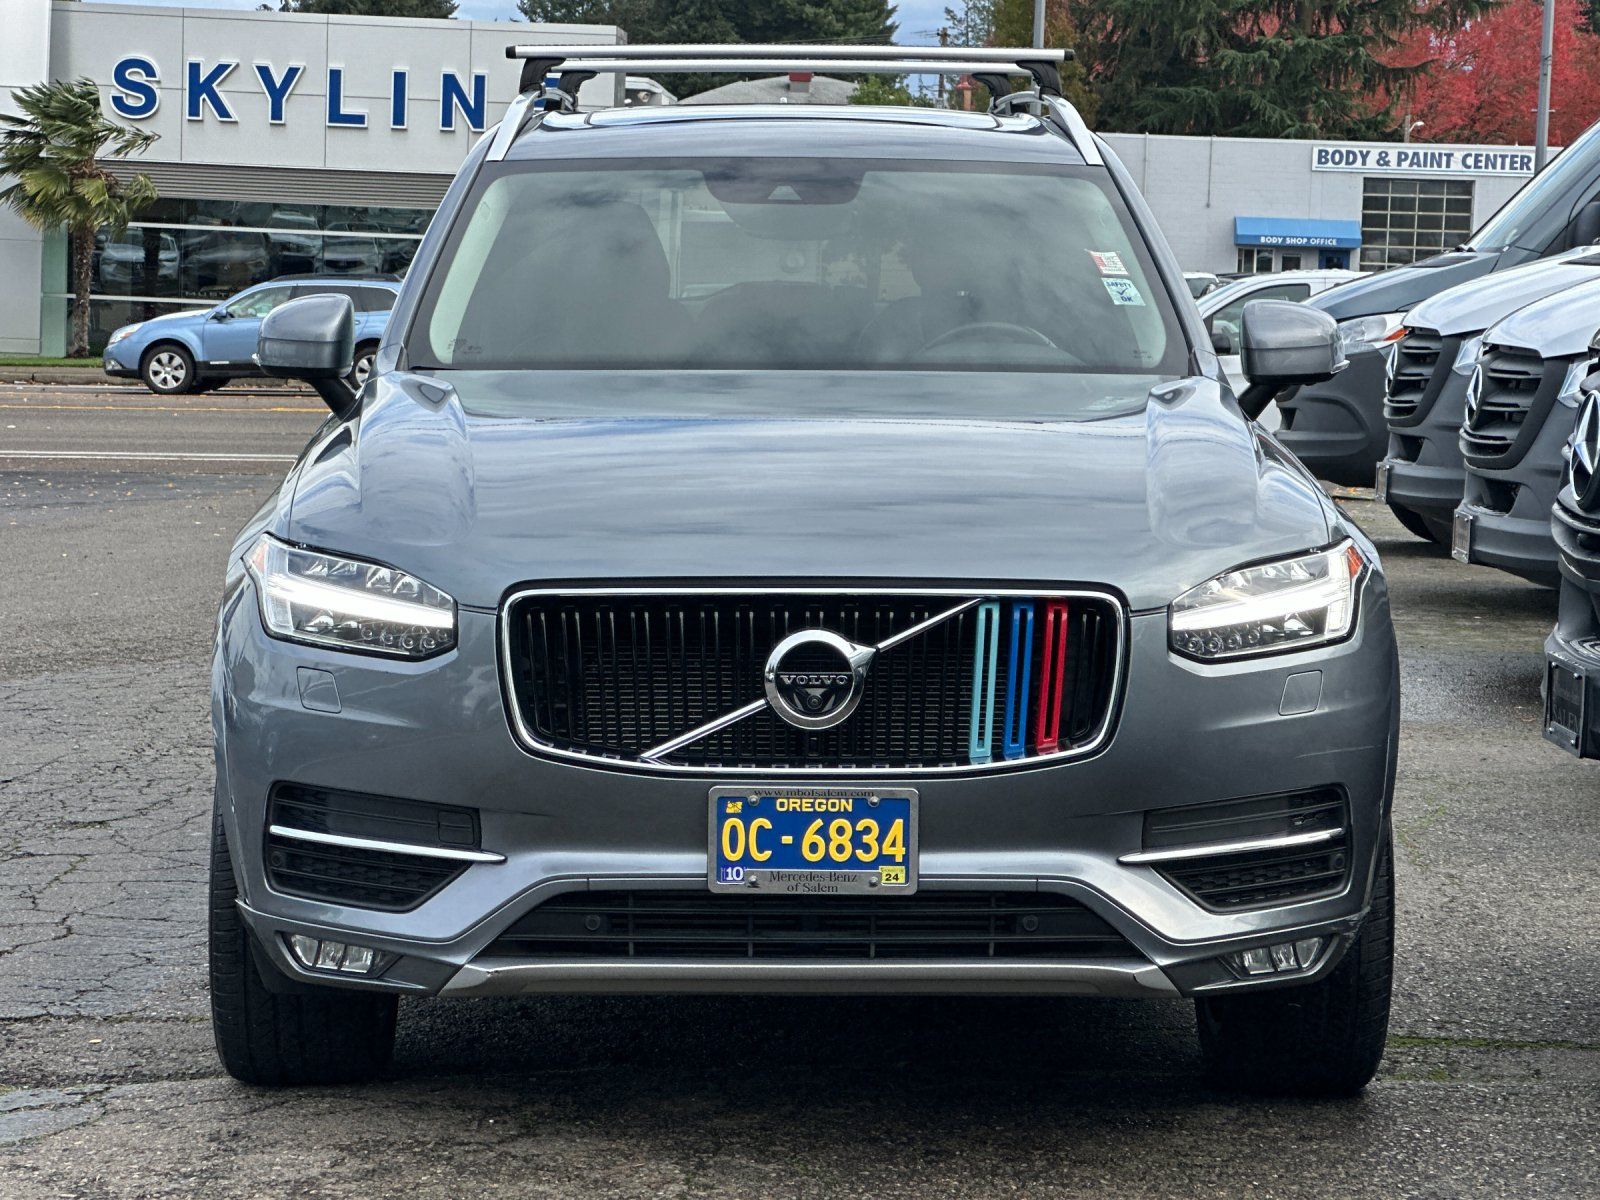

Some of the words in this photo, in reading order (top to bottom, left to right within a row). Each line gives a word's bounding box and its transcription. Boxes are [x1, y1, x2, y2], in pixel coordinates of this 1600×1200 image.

[111, 56, 561, 131] SKYLIN
[1317, 148, 1372, 167] BODY
[1376, 150, 1391, 167] &
[1397, 151, 1454, 169] PAINT
[1461, 152, 1532, 171] CENTER
[1260, 236, 1283, 244] BODY
[1286, 236, 1307, 245] SHOP
[1310, 237, 1337, 246] OFFICE
[780, 675, 848, 685] VOLVO
[754, 789, 874, 797] www.mbofsalem.com
[775, 798, 853, 812] OREGON
[726, 867, 744, 881] 10
[770, 871, 857, 882] Mercedes-Benz
[885, 873, 899, 882] 24
[787, 882, 801, 892] of
[803, 882, 838, 892] Salem
